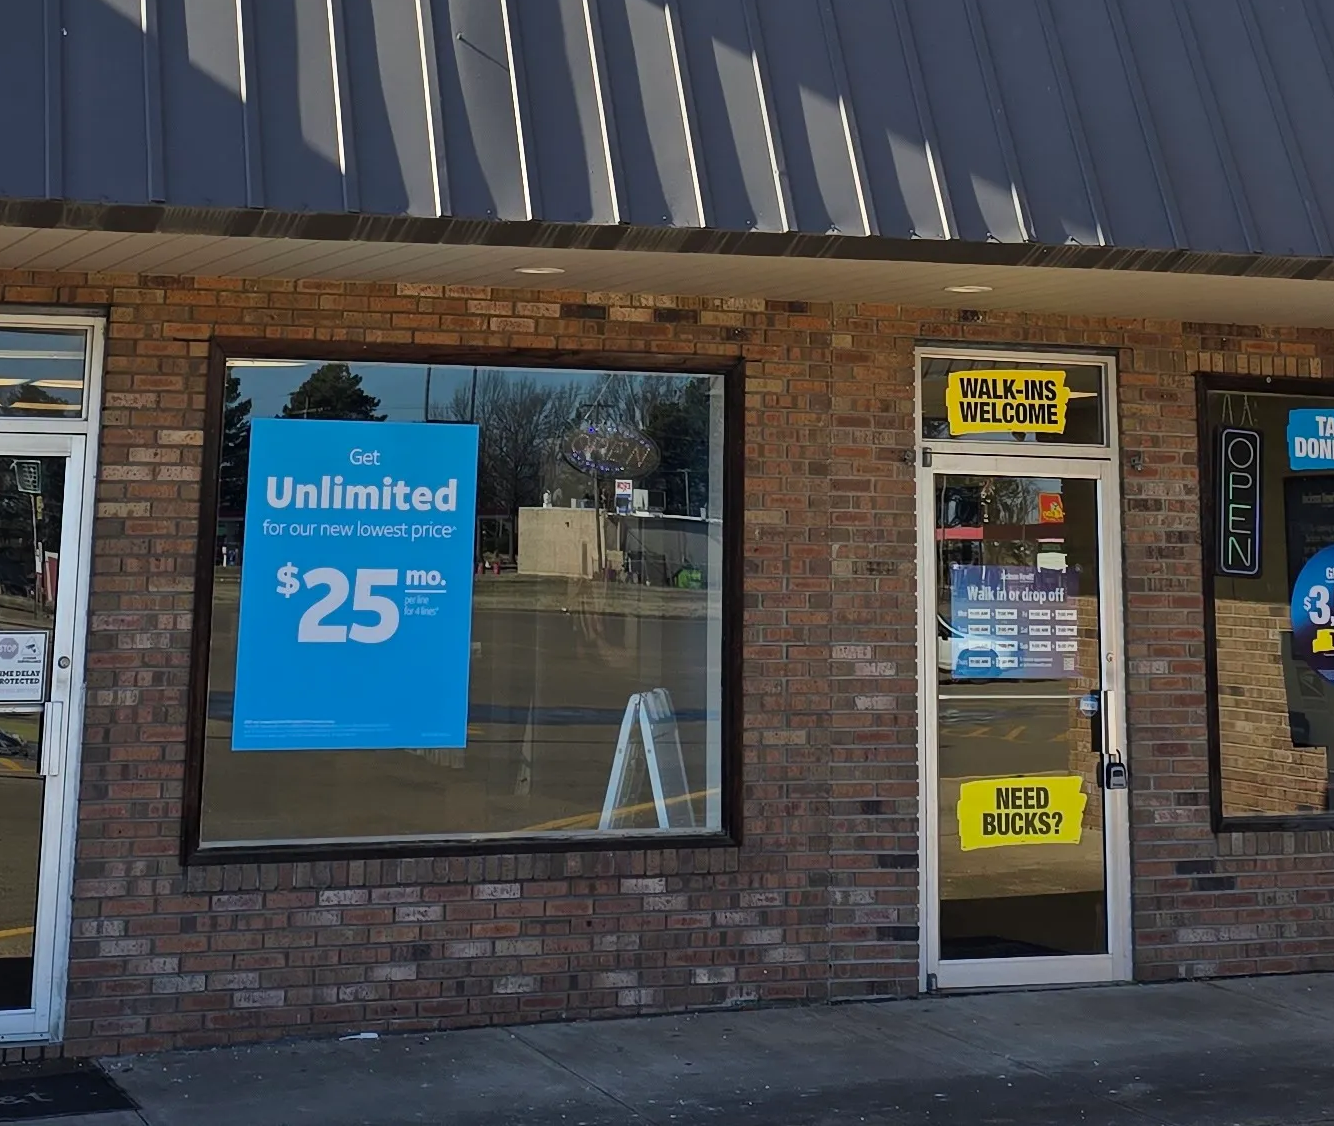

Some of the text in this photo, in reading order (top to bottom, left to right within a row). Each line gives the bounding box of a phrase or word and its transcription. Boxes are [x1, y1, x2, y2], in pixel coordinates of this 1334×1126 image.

[959, 378, 1057, 401] WALK-INS
[959, 401, 1058, 424] WELCOME
[350, 449, 380, 465] Get
[571, 433, 652, 468] OPEN
[267, 475, 457, 511] Unlimited
[1228, 438, 1254, 566] OPEN
[263, 519, 286, 536] for
[289, 523, 317, 536] our
[320, 524, 353, 536] new
[357, 521, 408, 537] lowest
[276, 562, 447, 644] $25 mo.
[417, 595, 429, 604] line
[967, 585, 1064, 604] Walk in or drop off
[0, 644, 18, 653] STOP
[995, 786, 1049, 810] NEED
[982, 812, 1063, 835] BUCKS?
